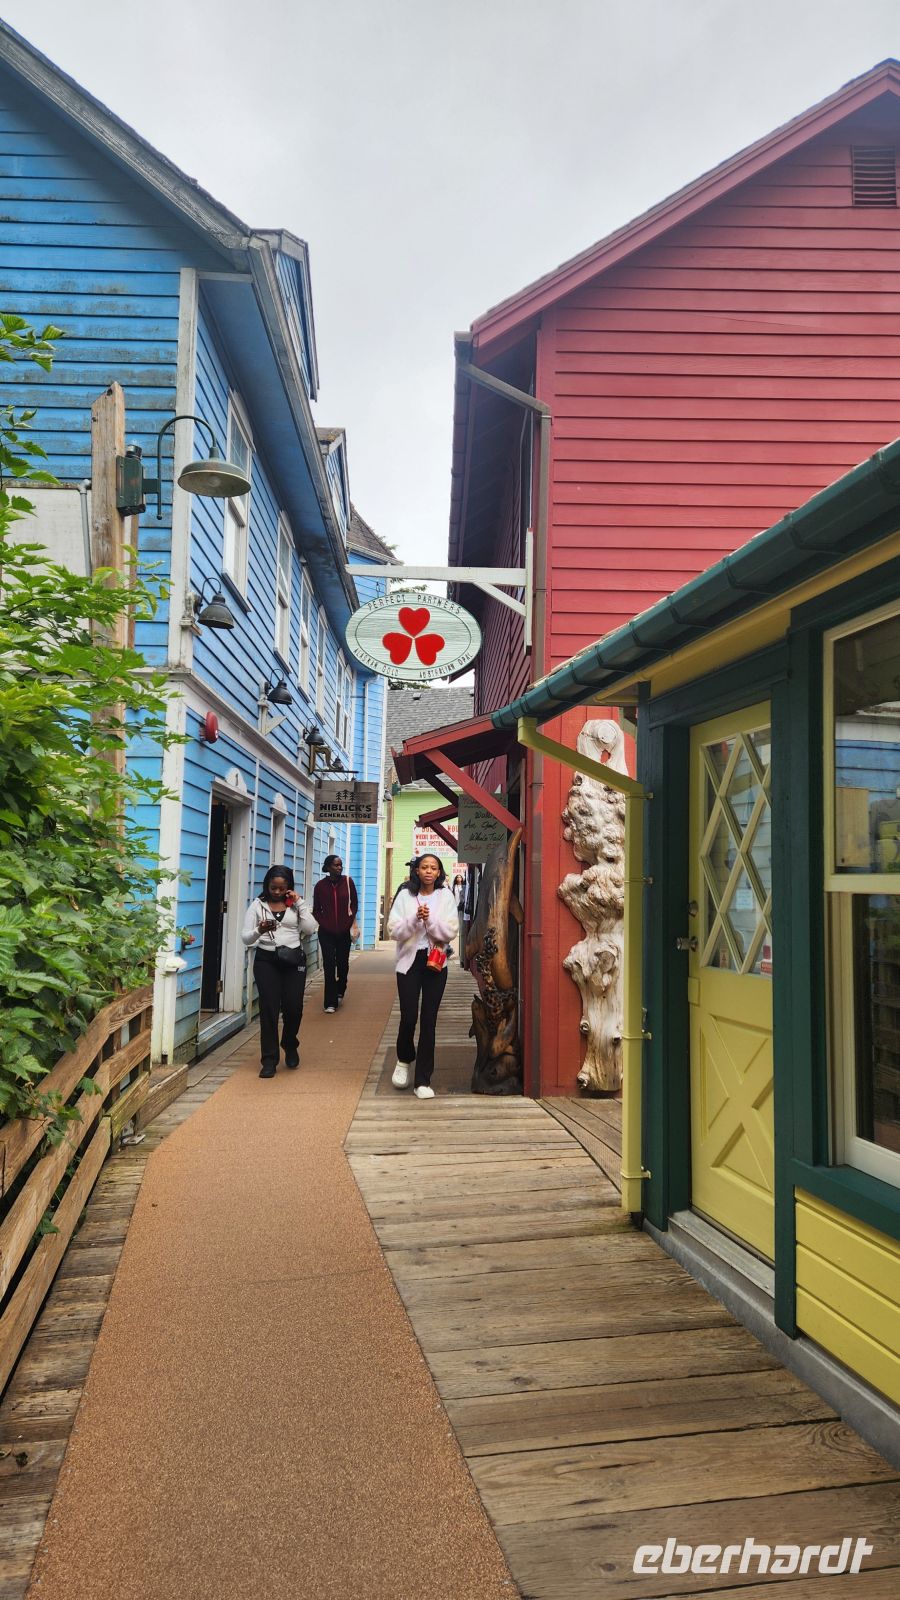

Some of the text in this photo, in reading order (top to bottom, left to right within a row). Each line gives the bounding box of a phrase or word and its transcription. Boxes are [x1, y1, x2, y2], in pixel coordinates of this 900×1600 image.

[367, 594, 463, 614] PERFECT PARTNERS
[353, 648, 474, 679] ALASKAN GOLD AUSTRALIAN OPAL
[319, 803, 372, 812] NIBLICK'S
